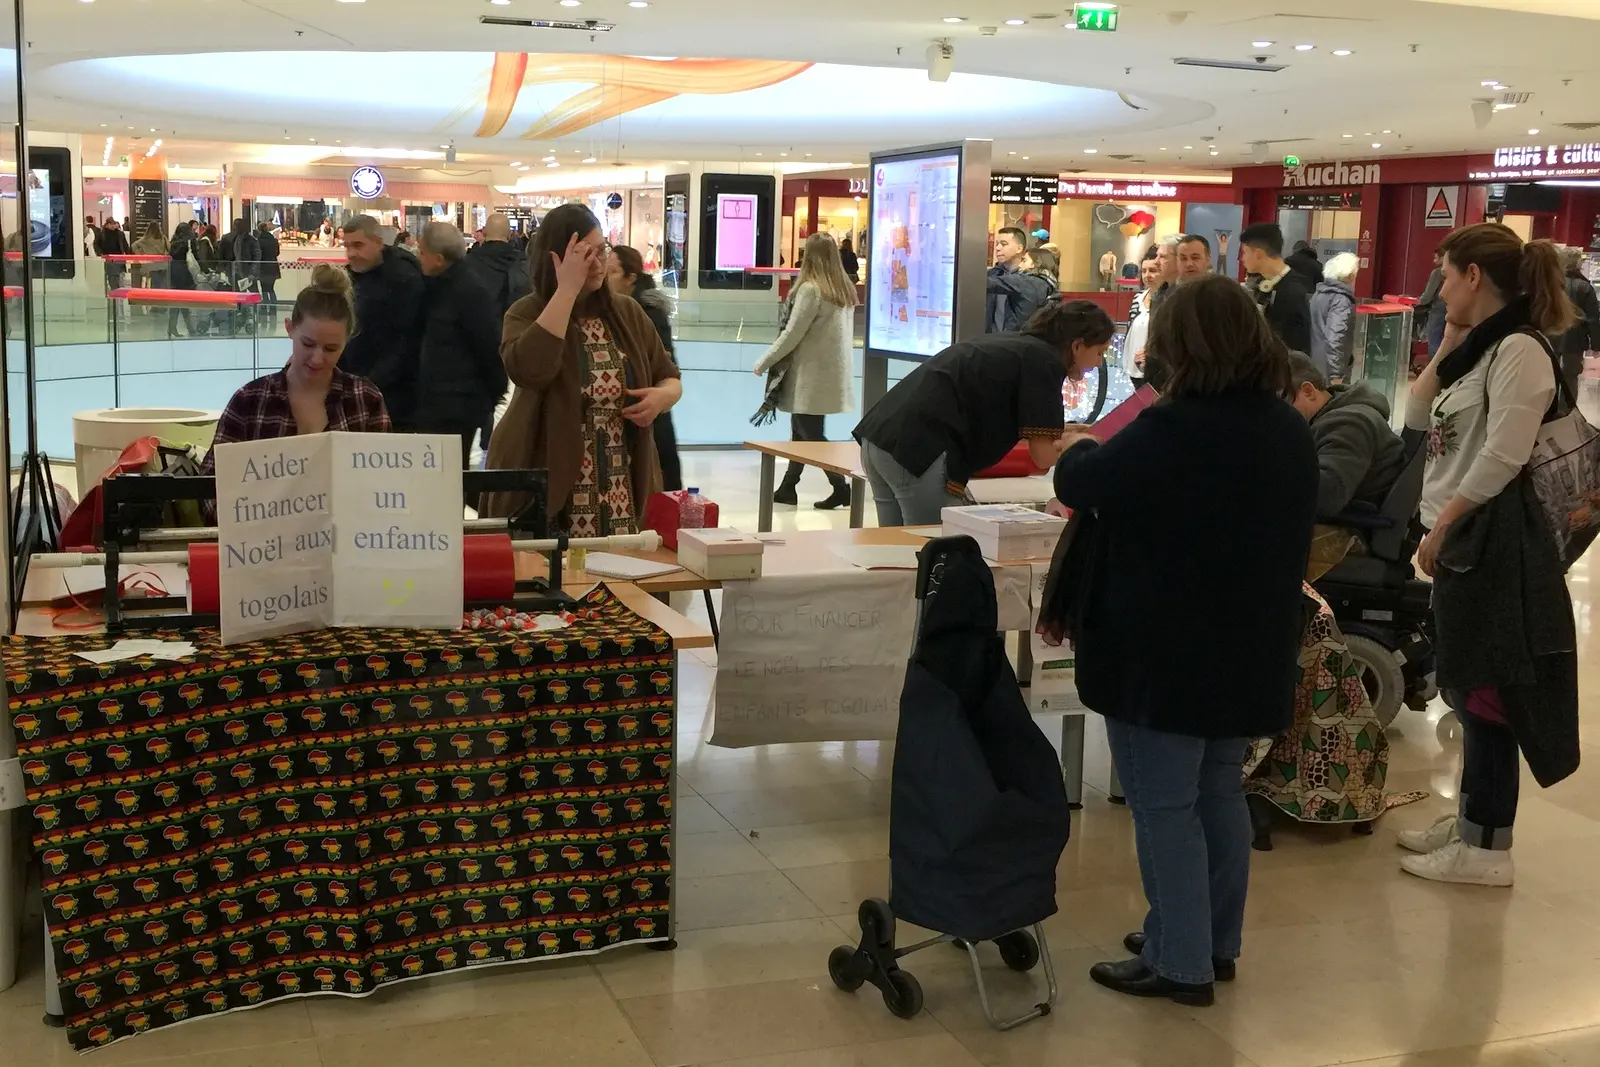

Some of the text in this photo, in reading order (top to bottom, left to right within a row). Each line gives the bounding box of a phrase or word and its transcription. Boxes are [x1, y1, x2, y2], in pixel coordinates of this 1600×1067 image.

[137, 185, 145, 197] 2
[1283, 160, 1381, 187] Auchan
[241, 445, 437, 483] Aider nous à
[233, 490, 406, 523] financer un
[225, 525, 449, 568] Noël aux enfants
[238, 581, 328, 620] togolais
[733, 594, 784, 633] POUR
